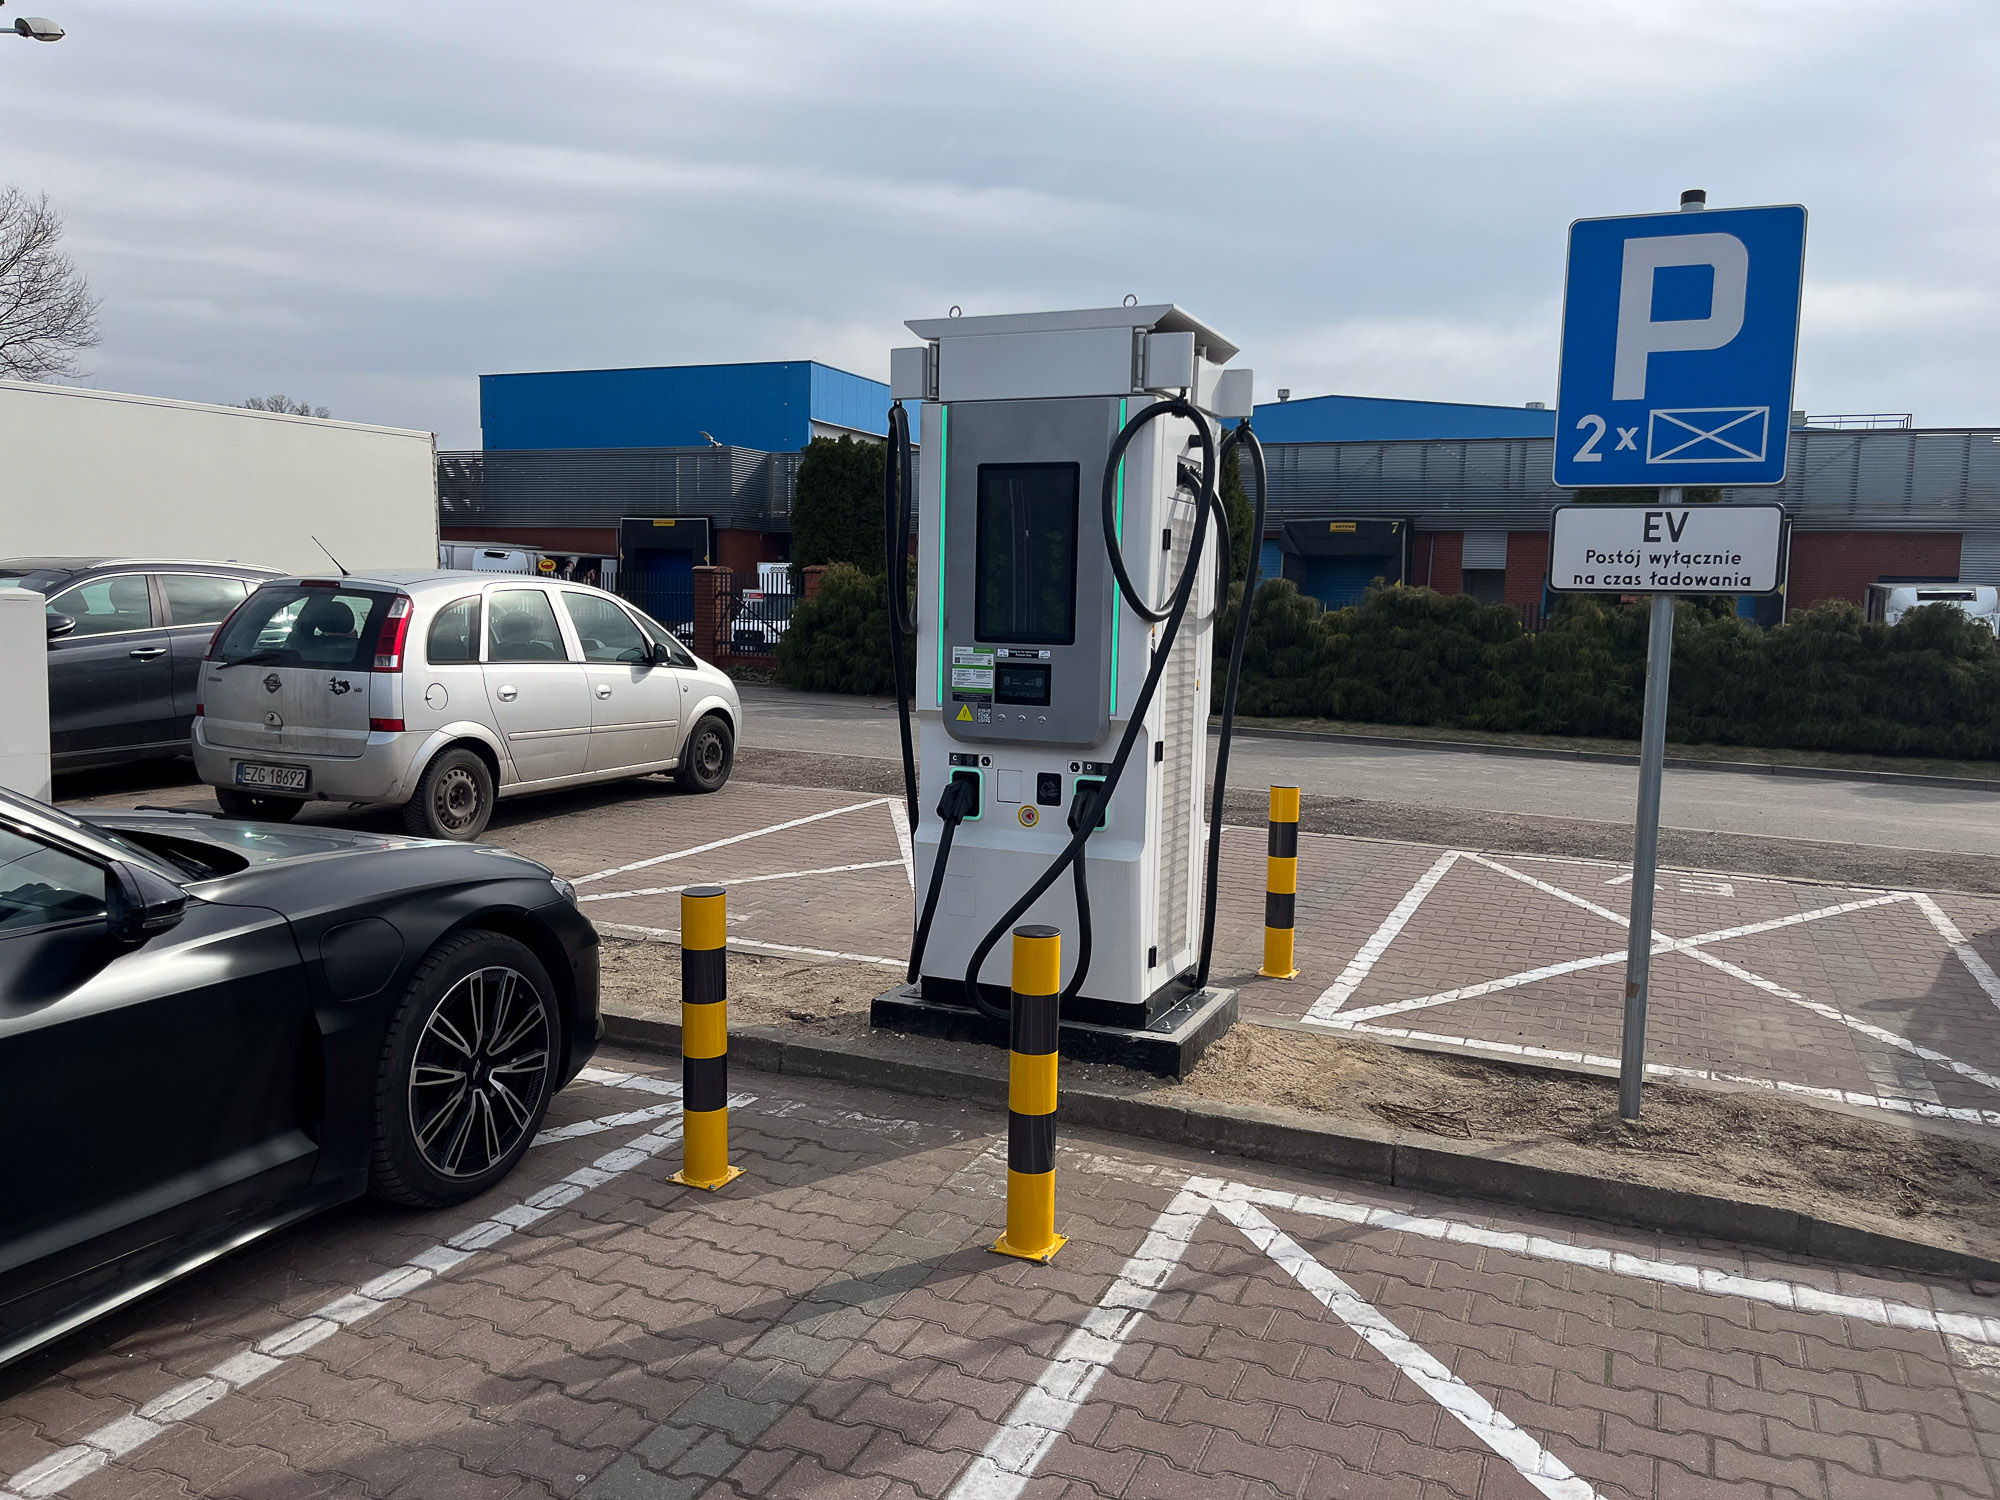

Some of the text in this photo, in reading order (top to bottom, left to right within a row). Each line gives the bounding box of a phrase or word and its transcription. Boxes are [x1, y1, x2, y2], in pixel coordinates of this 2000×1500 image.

[1612, 232, 1749, 401] P
[1573, 414, 1639, 462] 2 x
[1391, 522, 1399, 533] 7
[1643, 511, 1690, 543] EV
[1585, 549, 1742, 568] Postój wyłącznie
[1573, 571, 1751, 587] na czas ładowania
[243, 766, 305, 787] EZG 18692
